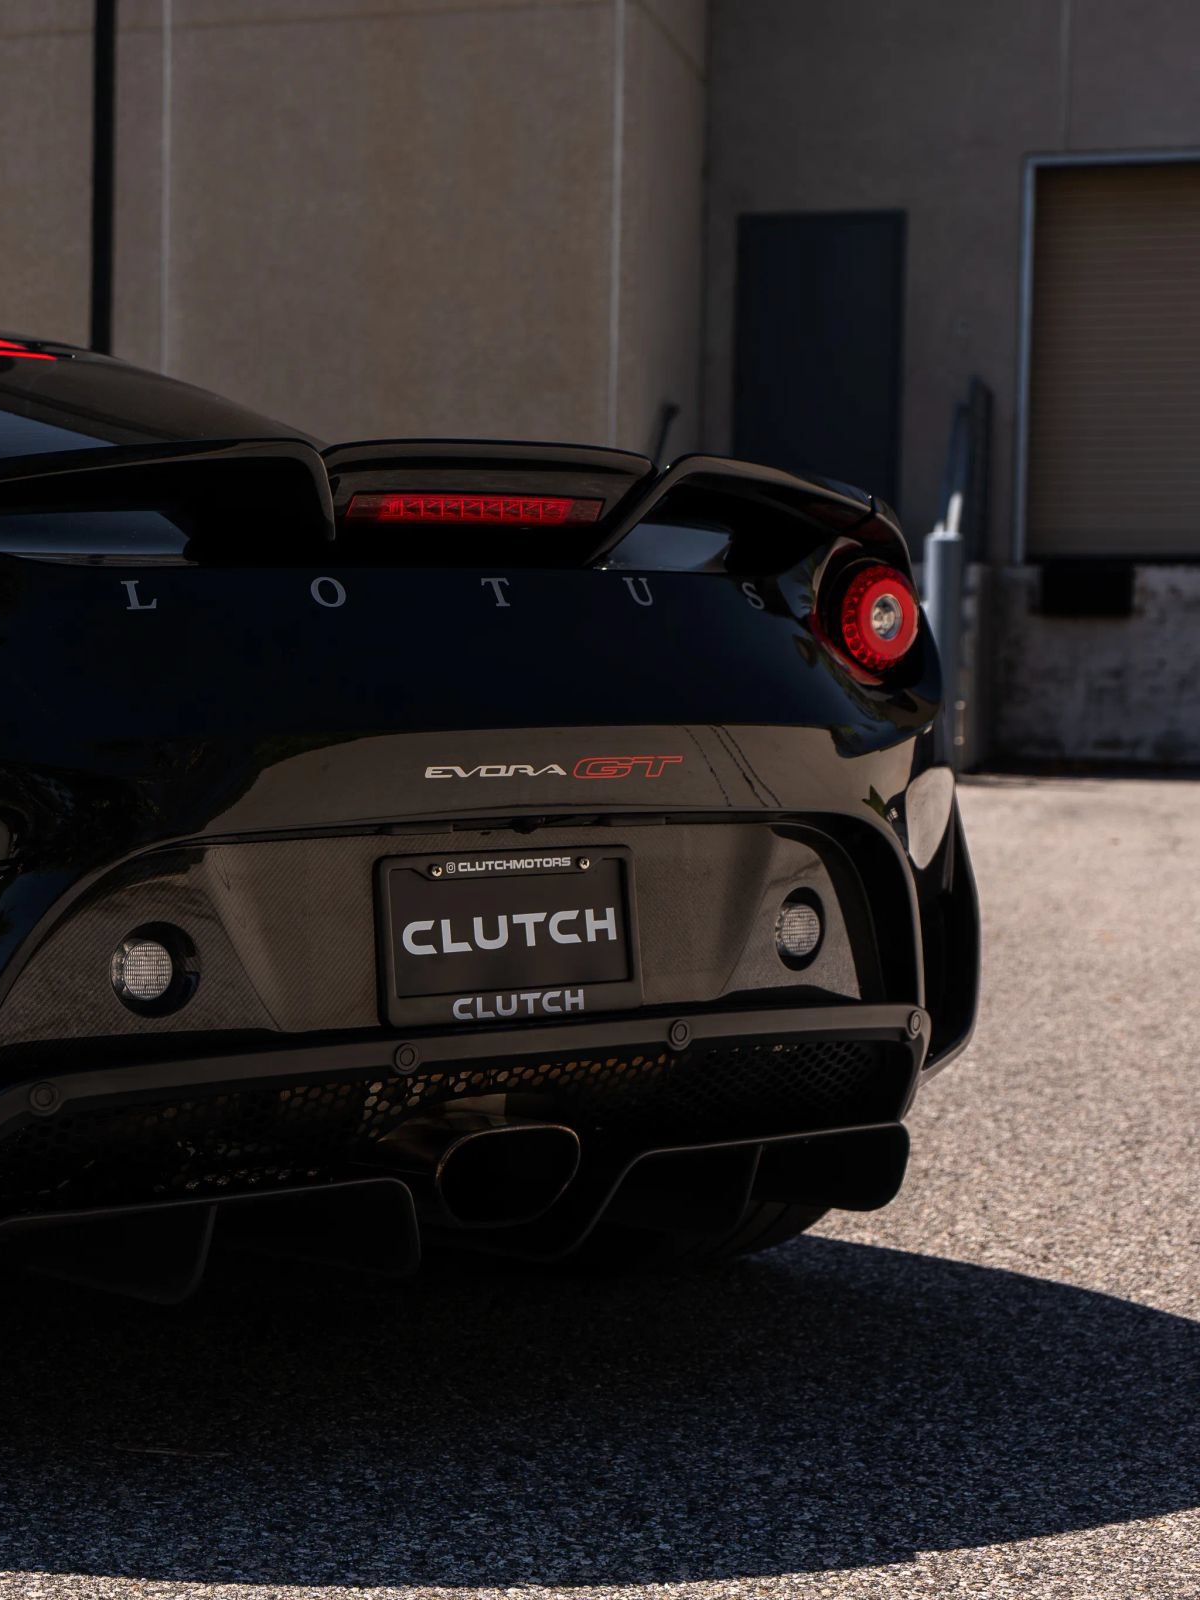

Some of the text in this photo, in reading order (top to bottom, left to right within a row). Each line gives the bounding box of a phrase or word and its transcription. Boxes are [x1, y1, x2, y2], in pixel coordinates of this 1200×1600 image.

[120, 576, 765, 611] LOTUS
[425, 755, 683, 779] EVORA GT
[457, 856, 572, 873] CLUTCHMOTORS
[402, 907, 618, 956] CLUTCH
[452, 988, 586, 1021] CLUTCH
